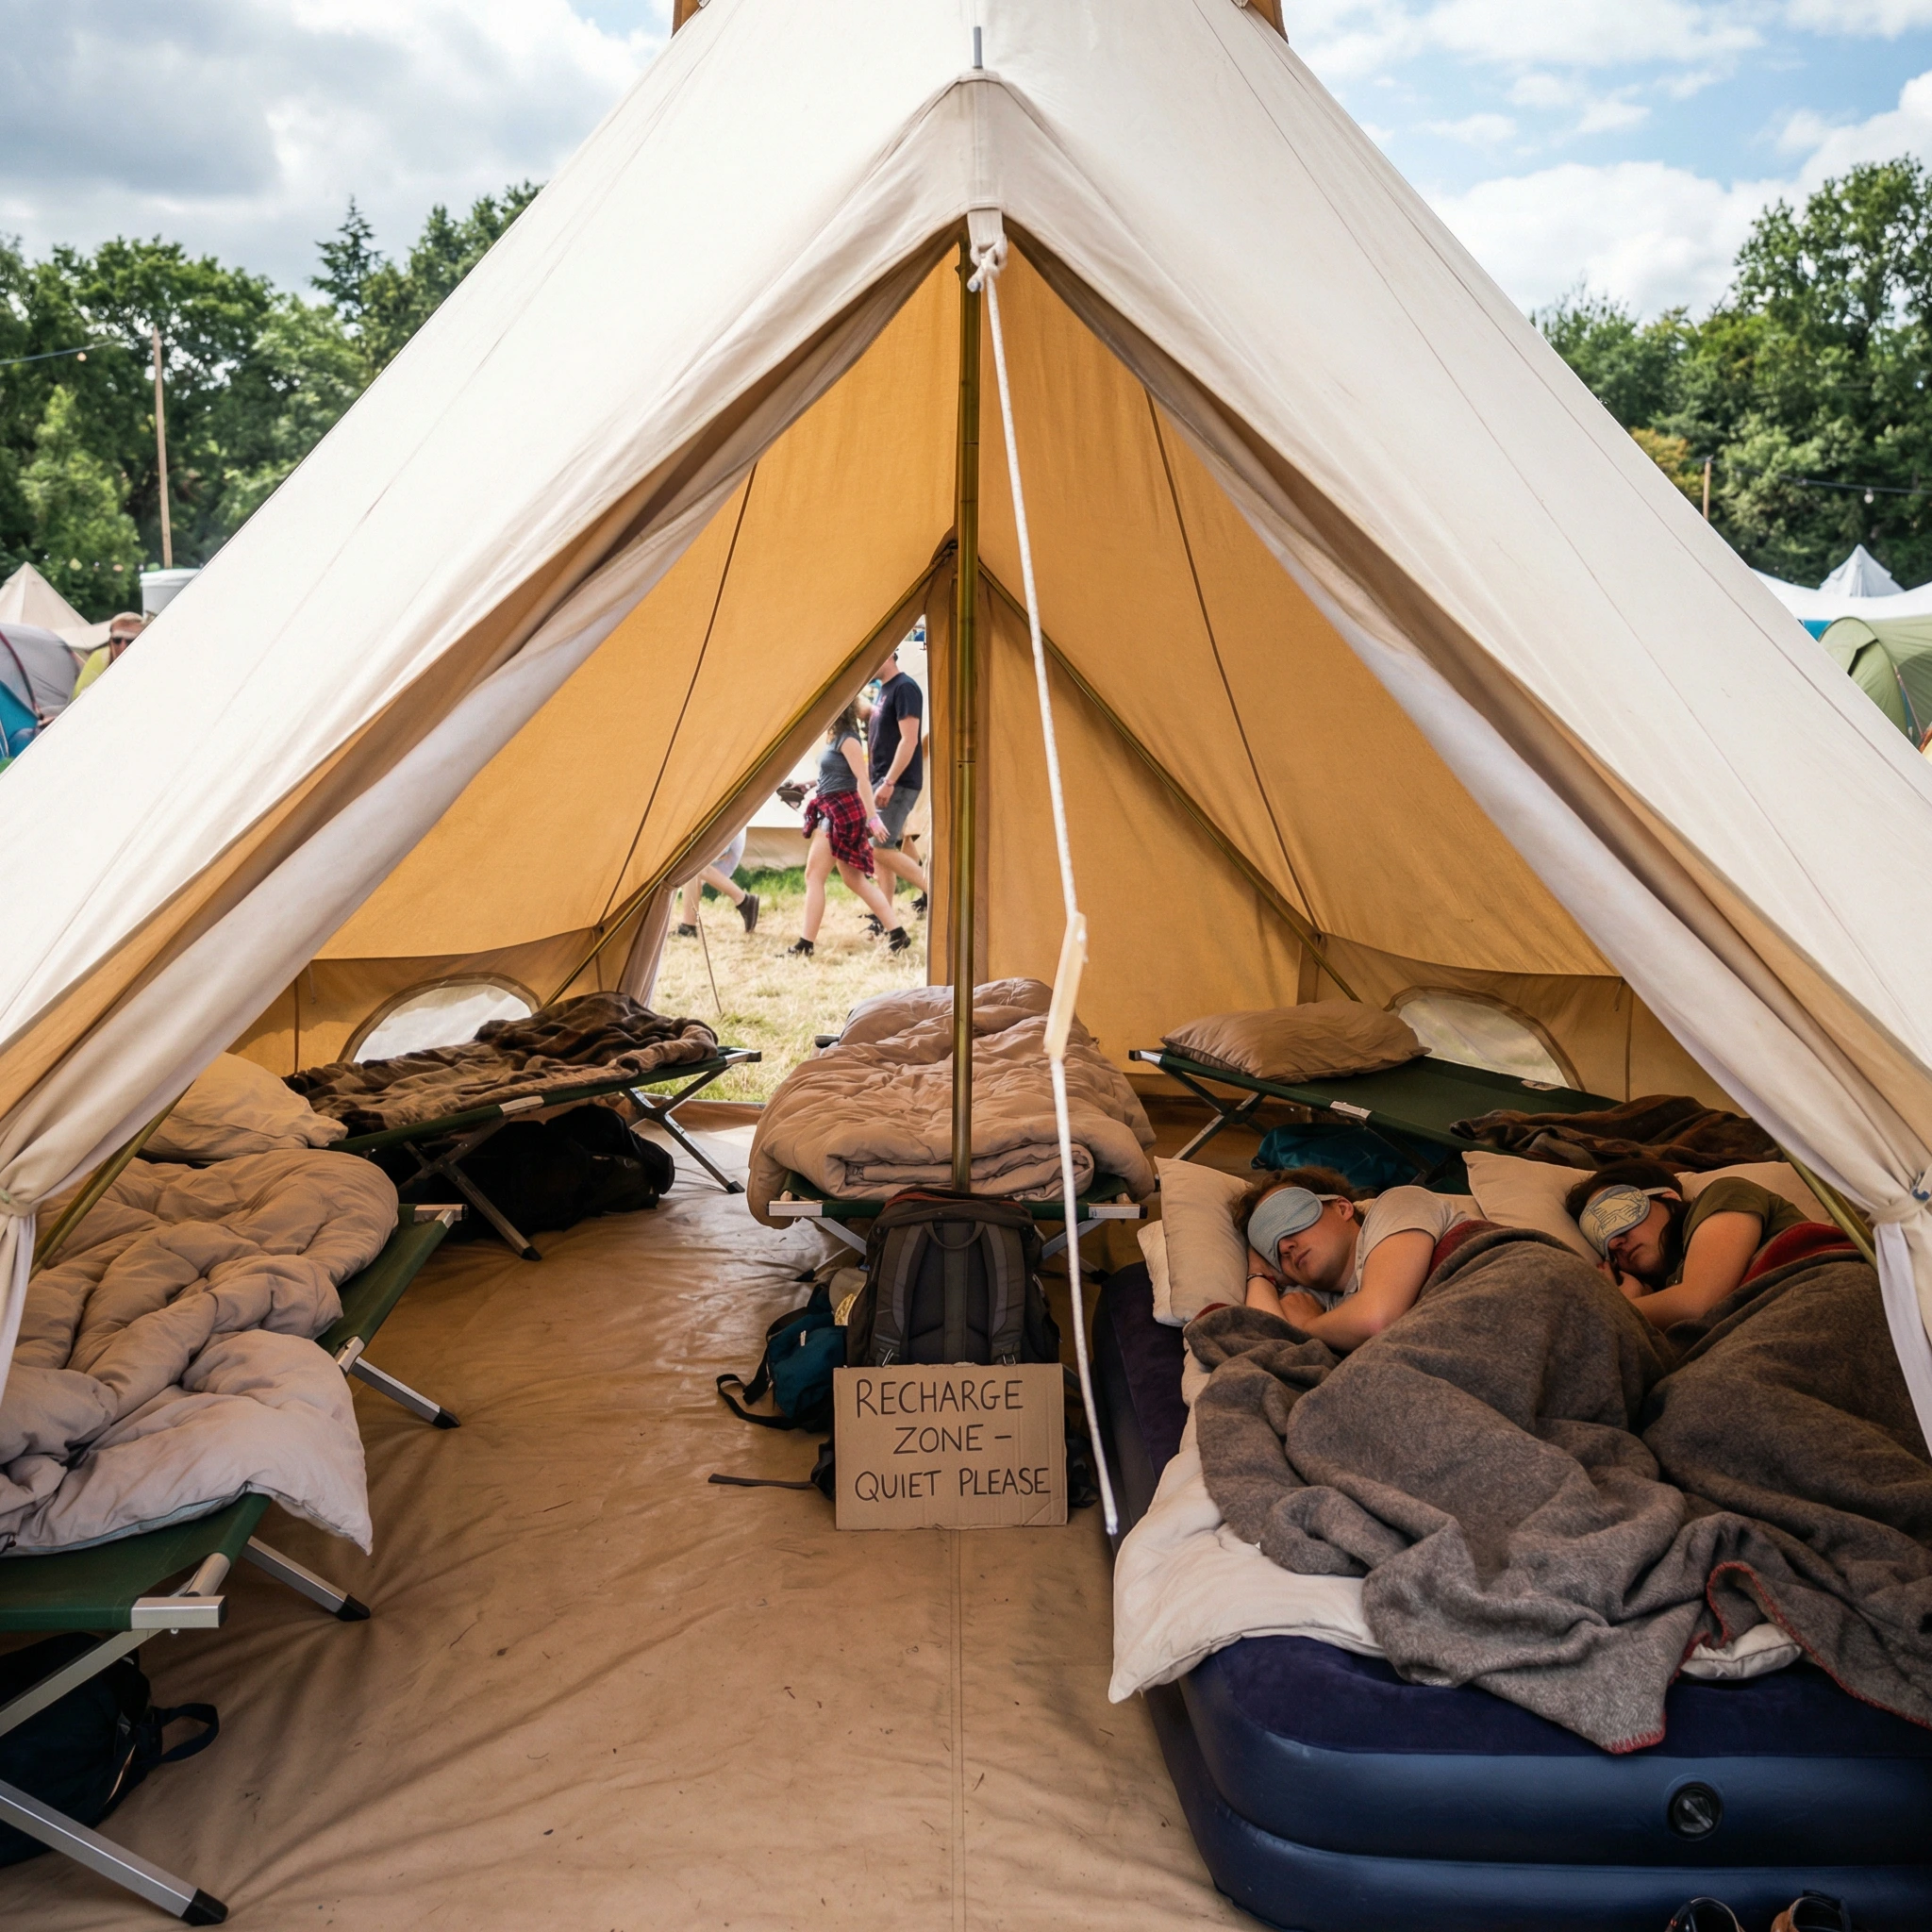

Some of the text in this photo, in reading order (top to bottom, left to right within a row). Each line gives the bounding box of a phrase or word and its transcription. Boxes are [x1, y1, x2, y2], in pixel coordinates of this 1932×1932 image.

[856, 1378, 1024, 1418] RECHARGE
[892, 1424, 984, 1455] ZONE
[855, 1467, 1051, 1503] QUIET PLEASE
